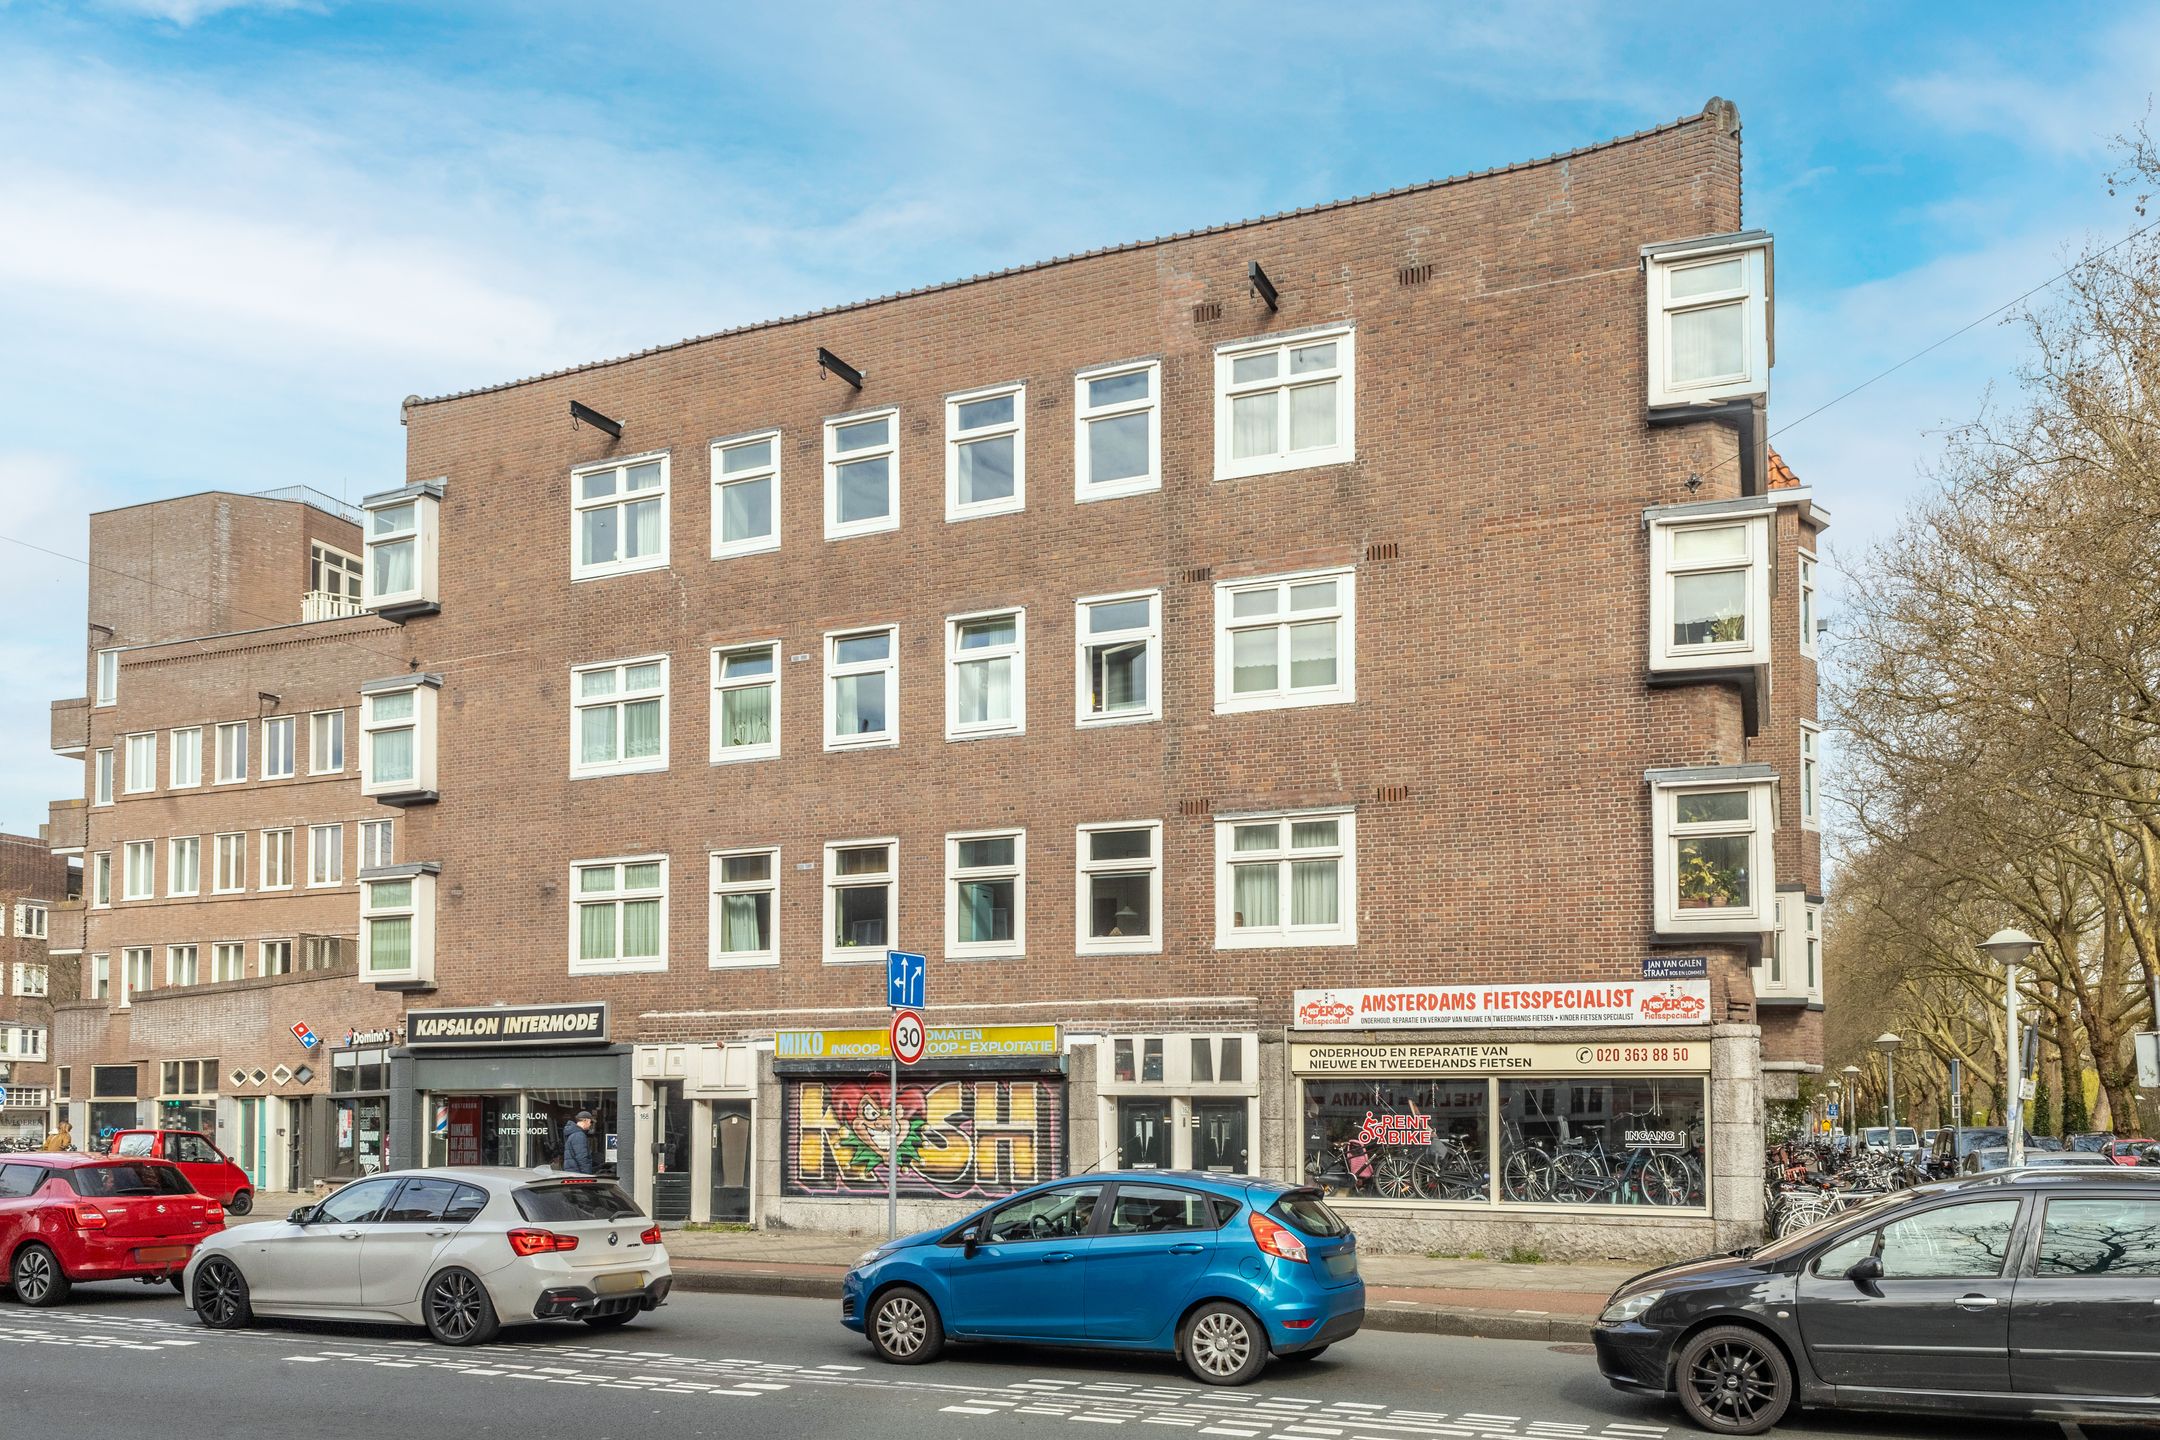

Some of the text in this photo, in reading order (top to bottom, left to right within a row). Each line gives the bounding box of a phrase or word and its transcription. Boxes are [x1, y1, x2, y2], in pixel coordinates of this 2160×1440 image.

[1648, 961, 1660, 969] JAN
[1678, 959, 1702, 967] GALEN
[1643, 969, 1669, 977] STRAAT
[1361, 989, 1635, 1012] AMSTERDAMS FIETSSPECIALIST
[416, 1013, 600, 1036] KAPSALON INTERMODE
[1492, 1014, 1531, 1022] TWEEDEHANDS
[1559, 1013, 1579, 1021] KINDER
[1580, 1013, 1602, 1021] FIETSEN
[353, 1028, 391, 1045] Domino's
[898, 1027, 920, 1047] 30
[926, 1029, 982, 1040] OMATEN
[778, 1032, 824, 1055] MIKO
[831, 1043, 881, 1055] INKOOP
[969, 1040, 1053, 1053] EXPLOITATIE
[1309, 1046, 1508, 1058] ONDERHOUD EN REPARATIE VAN
[1597, 1048, 1688, 1062] 020 363 88 50
[1309, 1058, 1532, 1069] NIEUWE EN TWEEDEHANDS FIETSEN
[501, 1112, 548, 1120] KAPSALON
[1382, 1115, 1431, 1129] RENT
[1387, 1130, 1432, 1145] BIKE
[1624, 1130, 1675, 1141] INGANG
